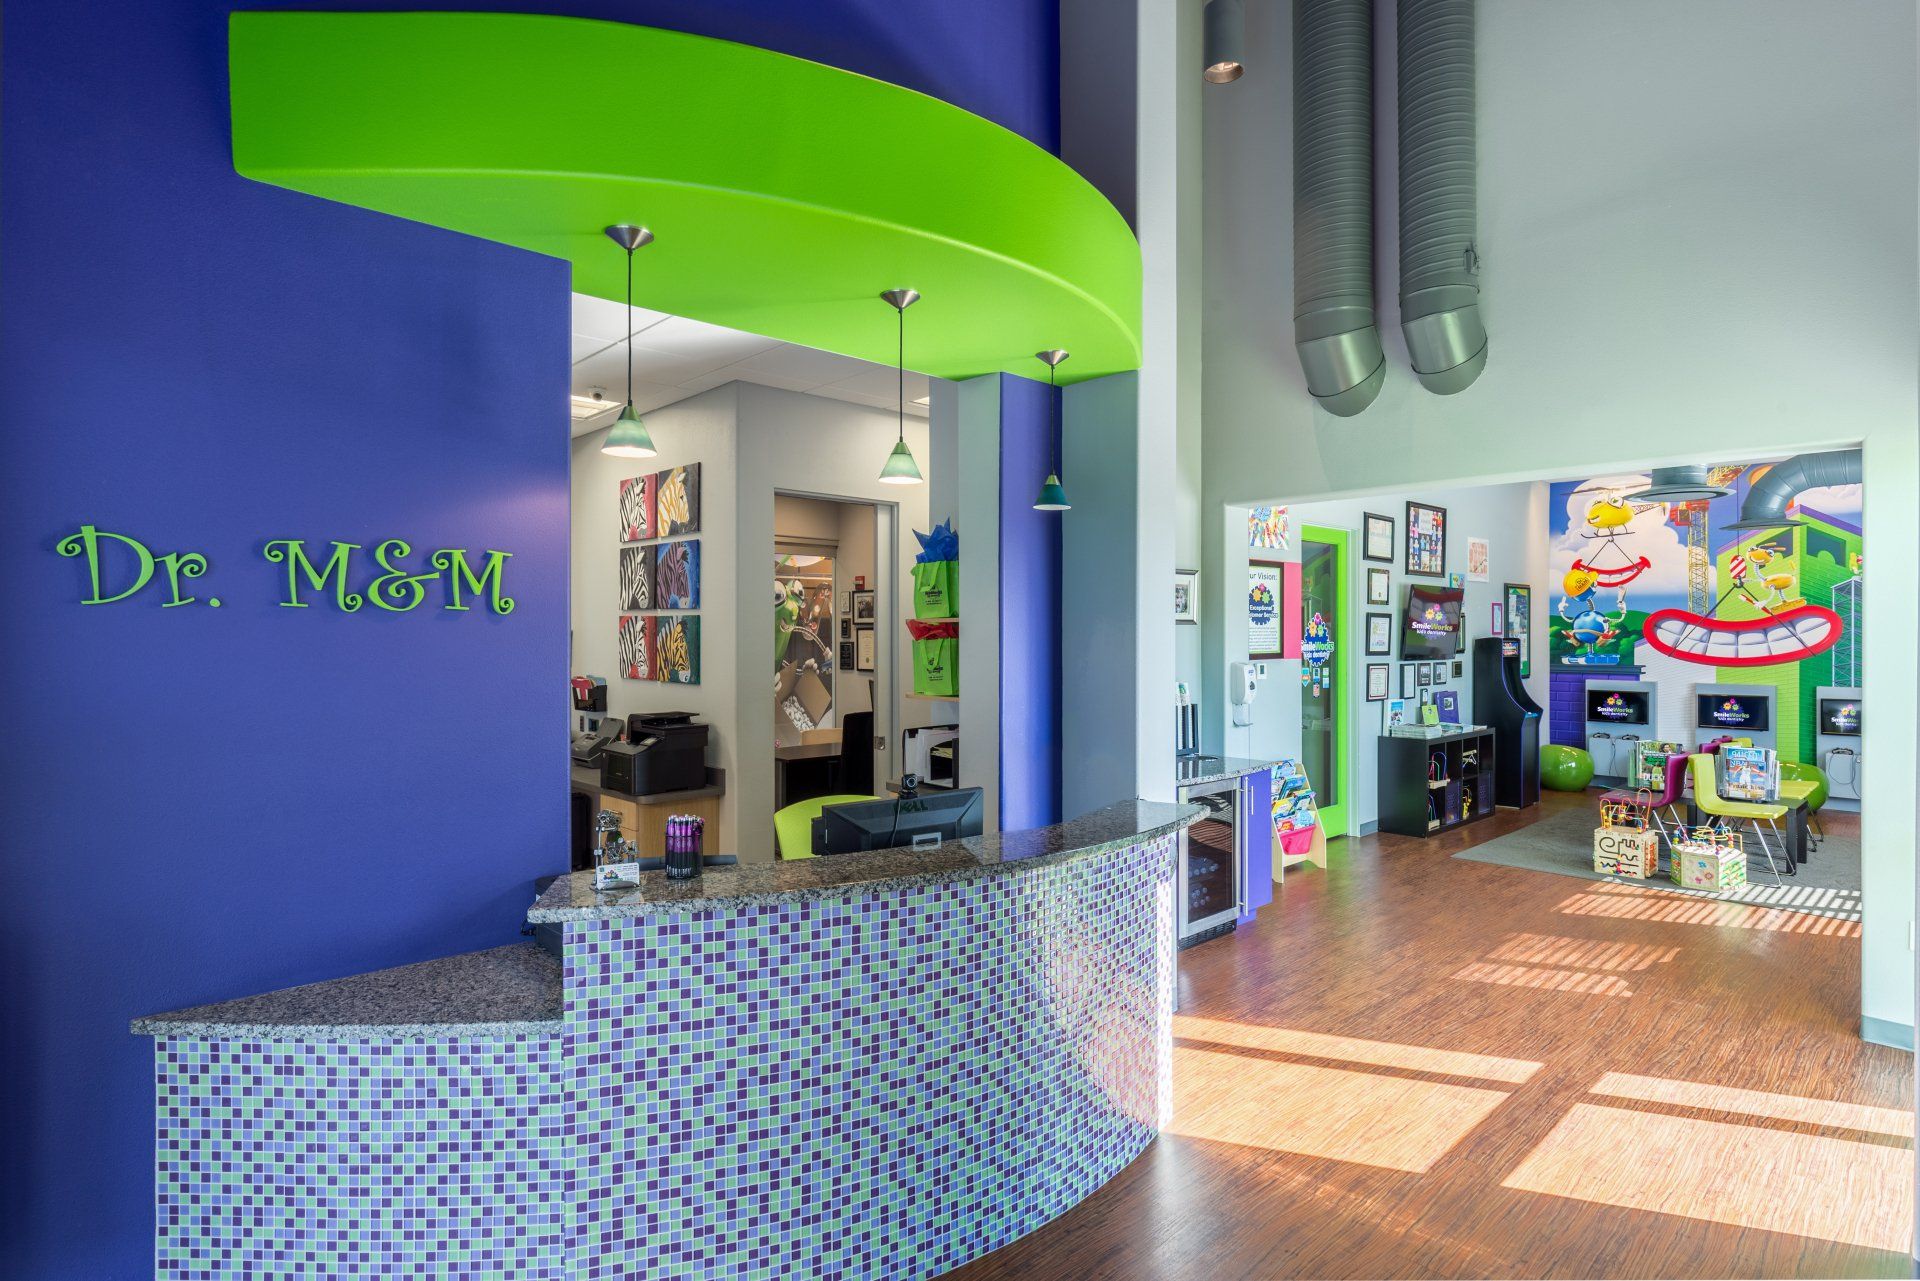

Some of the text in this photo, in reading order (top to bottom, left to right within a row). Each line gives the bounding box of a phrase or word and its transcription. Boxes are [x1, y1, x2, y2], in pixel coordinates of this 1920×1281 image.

[57, 525, 515, 615] Dr. M&M
[1257, 572, 1278, 581] Vision:
[1411, 621, 1453, 631] SmileWorks
[1713, 711, 1750, 719] SmileWorks
